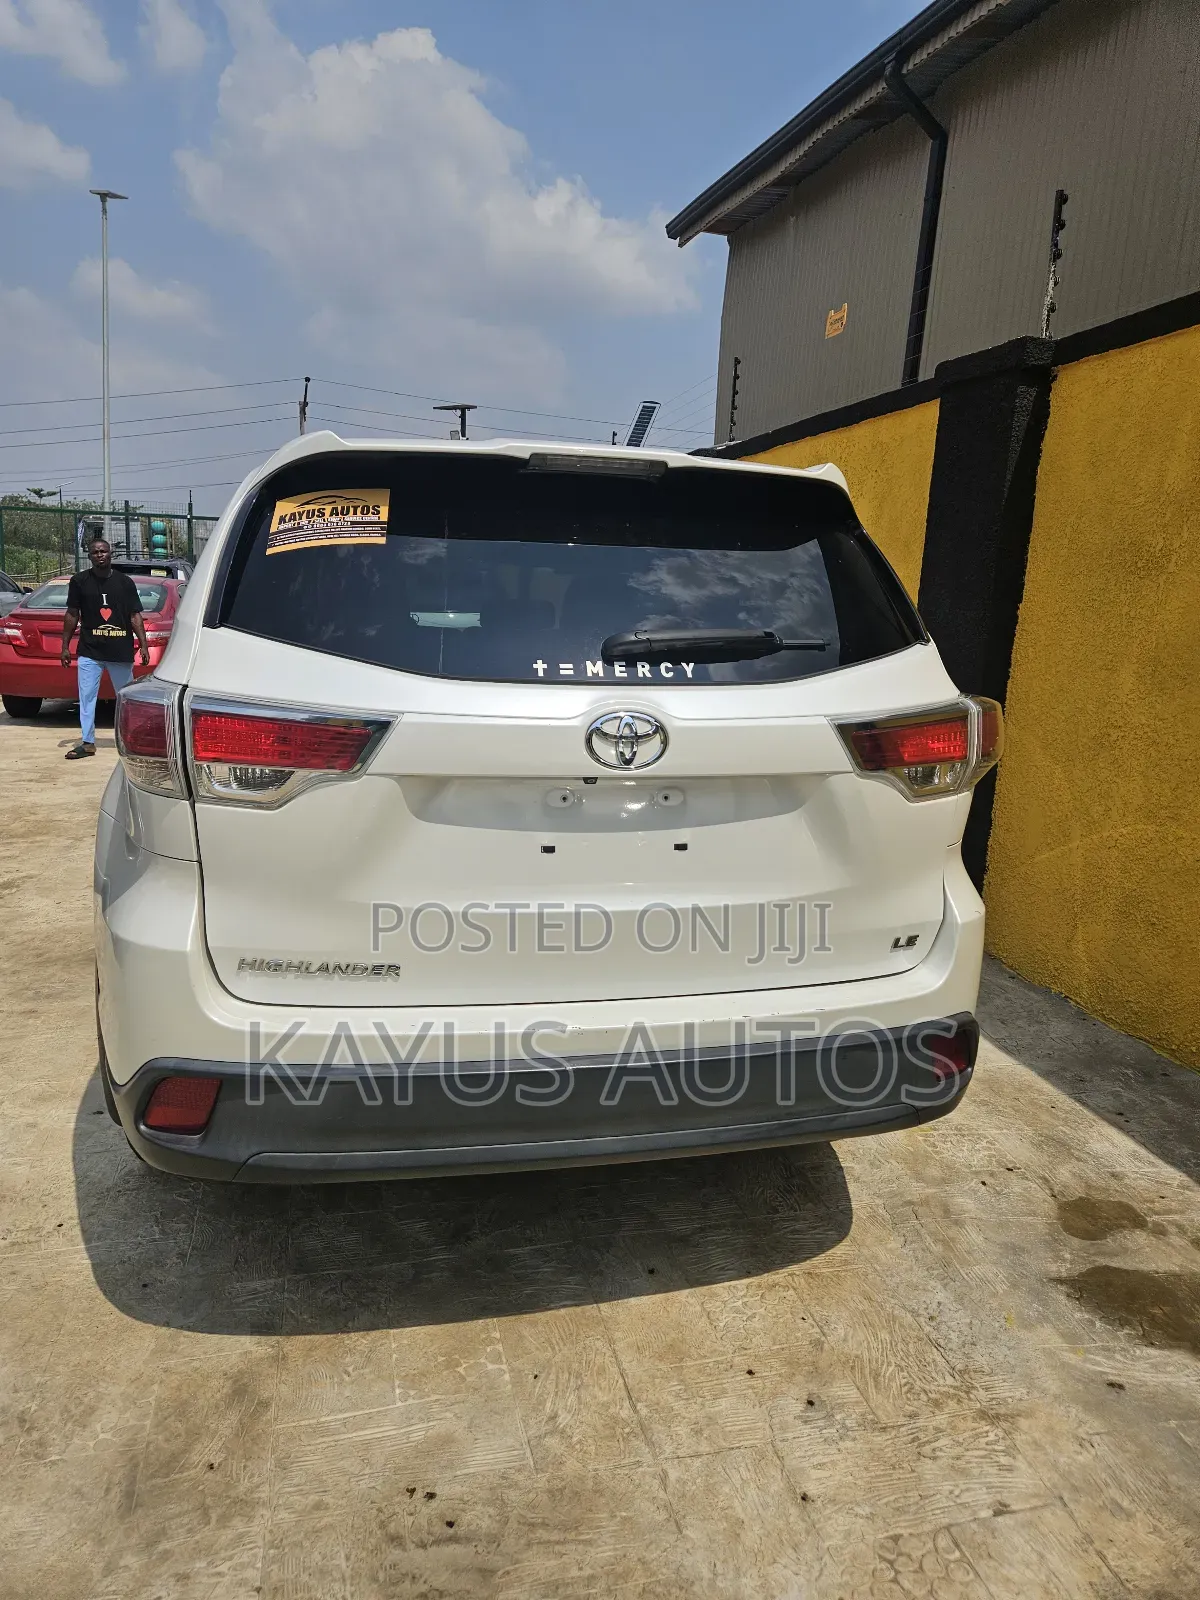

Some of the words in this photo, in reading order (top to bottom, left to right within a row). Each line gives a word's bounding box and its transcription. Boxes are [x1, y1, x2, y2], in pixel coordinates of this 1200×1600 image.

[278, 507, 326, 526] KAYUS
[329, 504, 381, 517] AUTOS
[101, 593, 109, 606] I
[585, 660, 695, 678] MERCY
[890, 934, 919, 949] LE
[236, 957, 401, 978] HIGHLANDER
